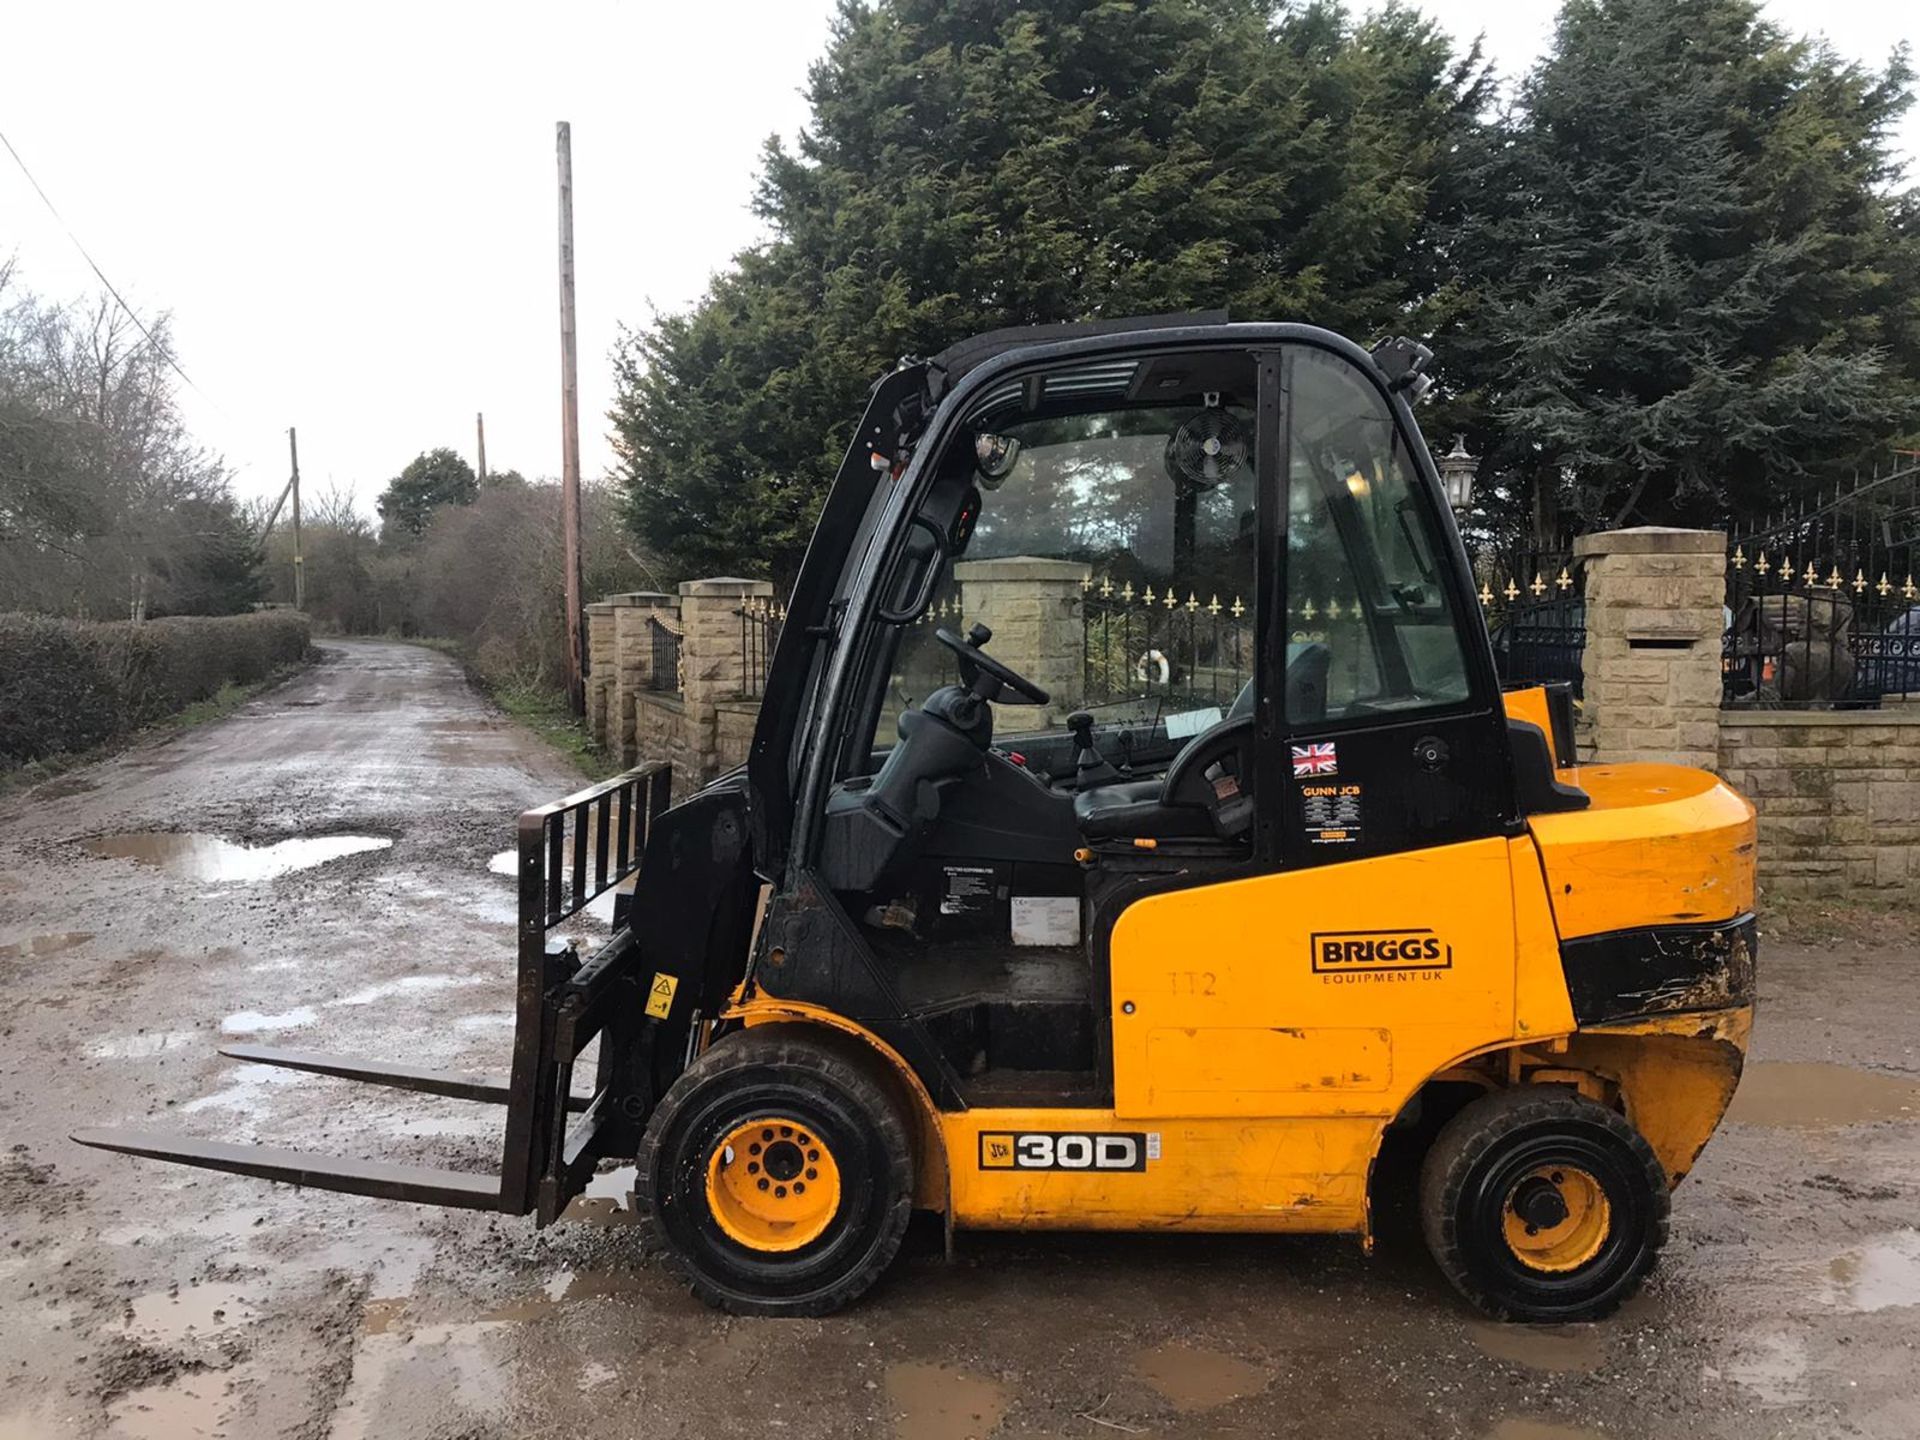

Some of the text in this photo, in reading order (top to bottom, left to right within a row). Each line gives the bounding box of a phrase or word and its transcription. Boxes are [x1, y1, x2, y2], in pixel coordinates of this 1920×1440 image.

[1303, 786, 1360, 796] GUNN JCB
[1322, 938, 1440, 963] BRIGGS
[1323, 971, 1443, 985] EQUIPMENT UK
[1018, 1135, 1137, 1167] 30D
